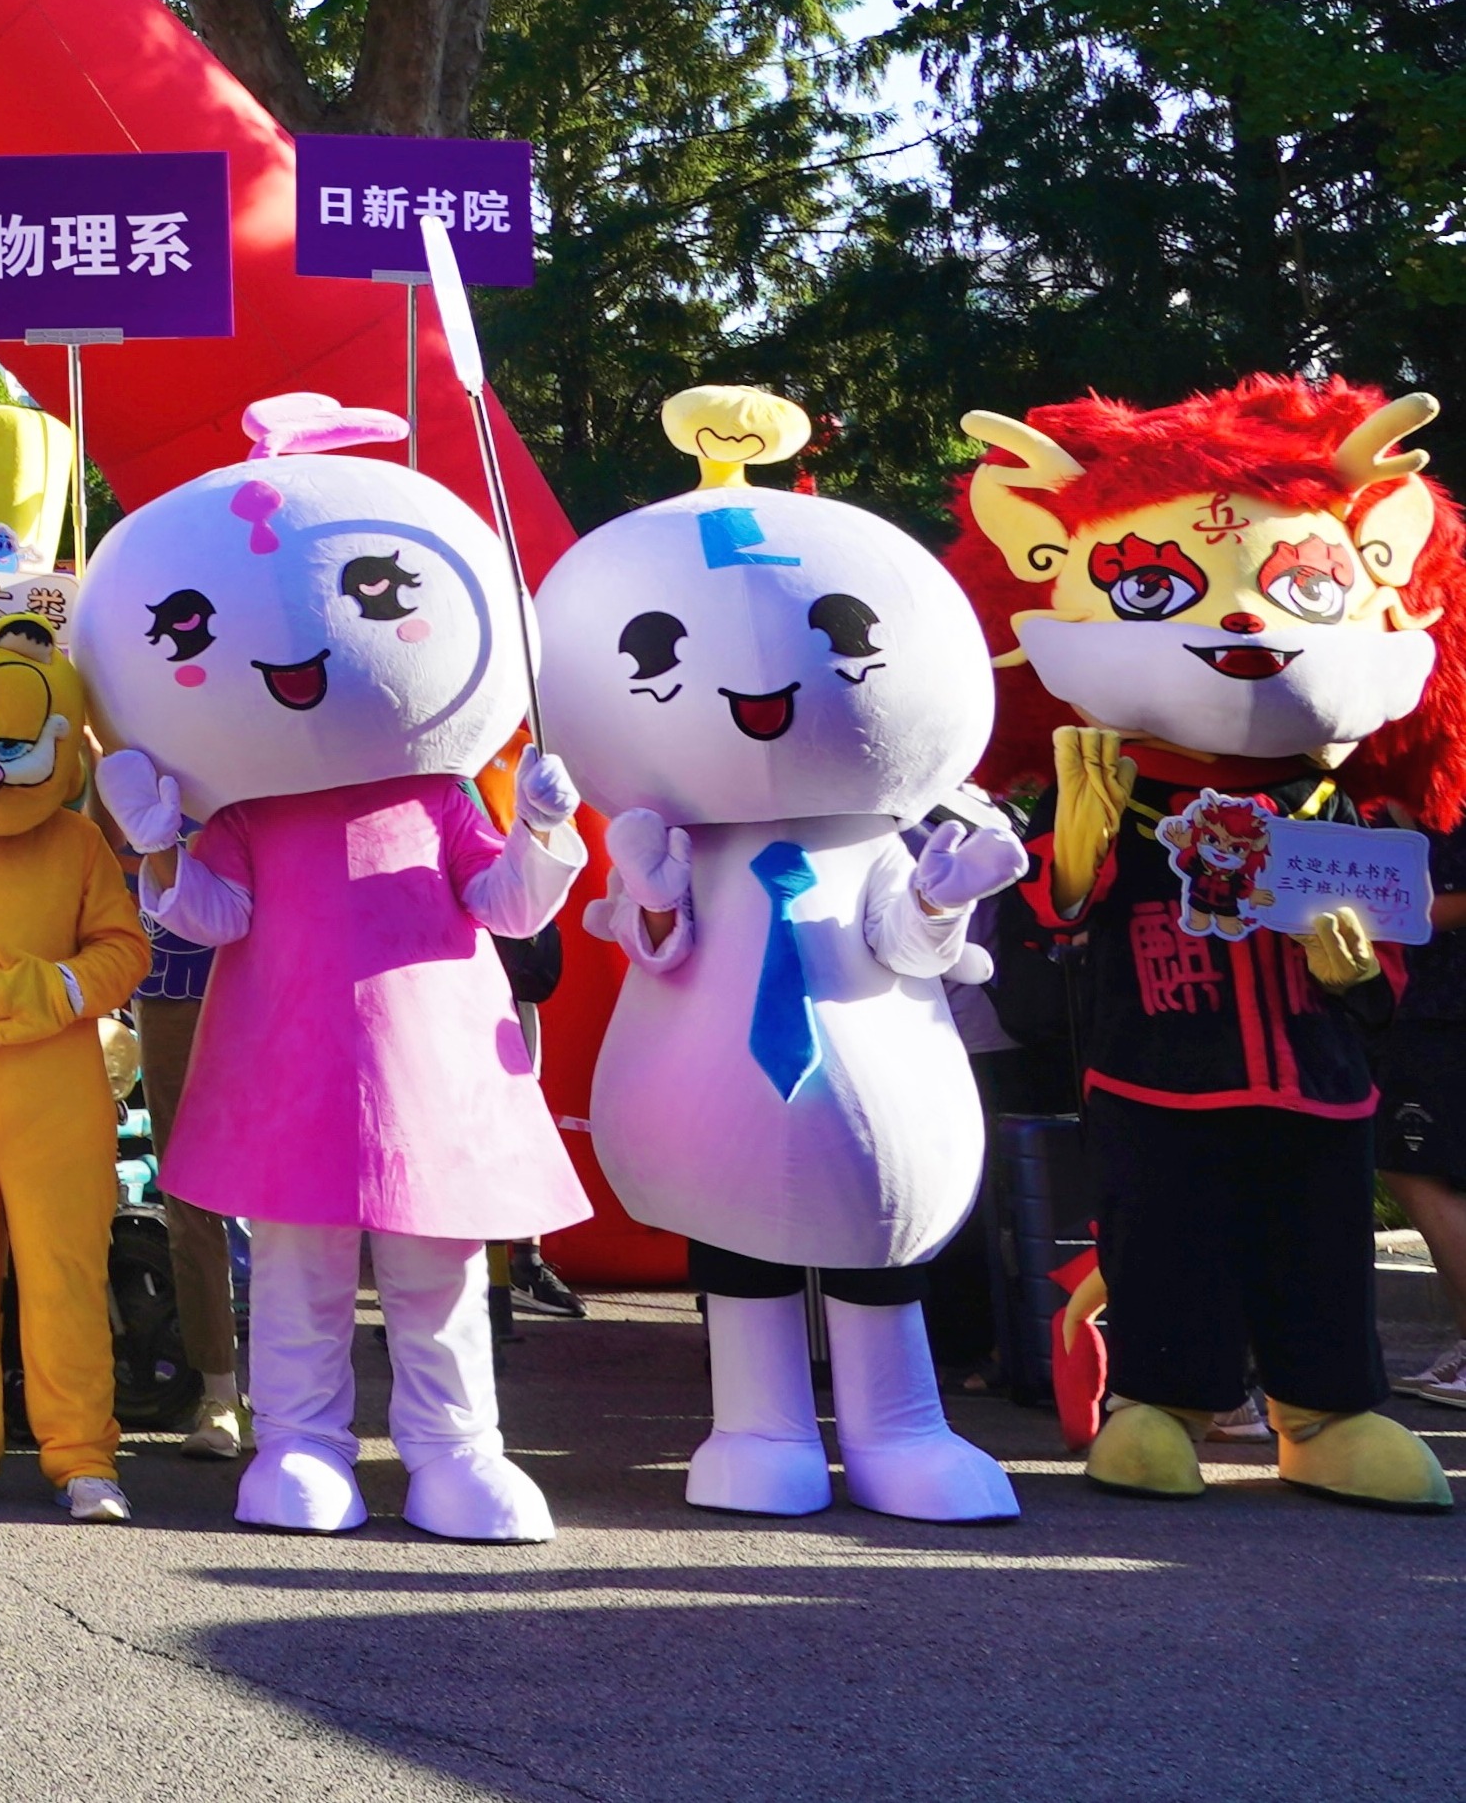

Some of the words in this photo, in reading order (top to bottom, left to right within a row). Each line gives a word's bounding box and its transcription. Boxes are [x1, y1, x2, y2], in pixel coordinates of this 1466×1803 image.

[320, 185, 511, 233] 日新书院
[1287, 855, 1401, 883] 欢迎求真书院
[1277, 877, 1411, 904] 三字班小伙伴们
